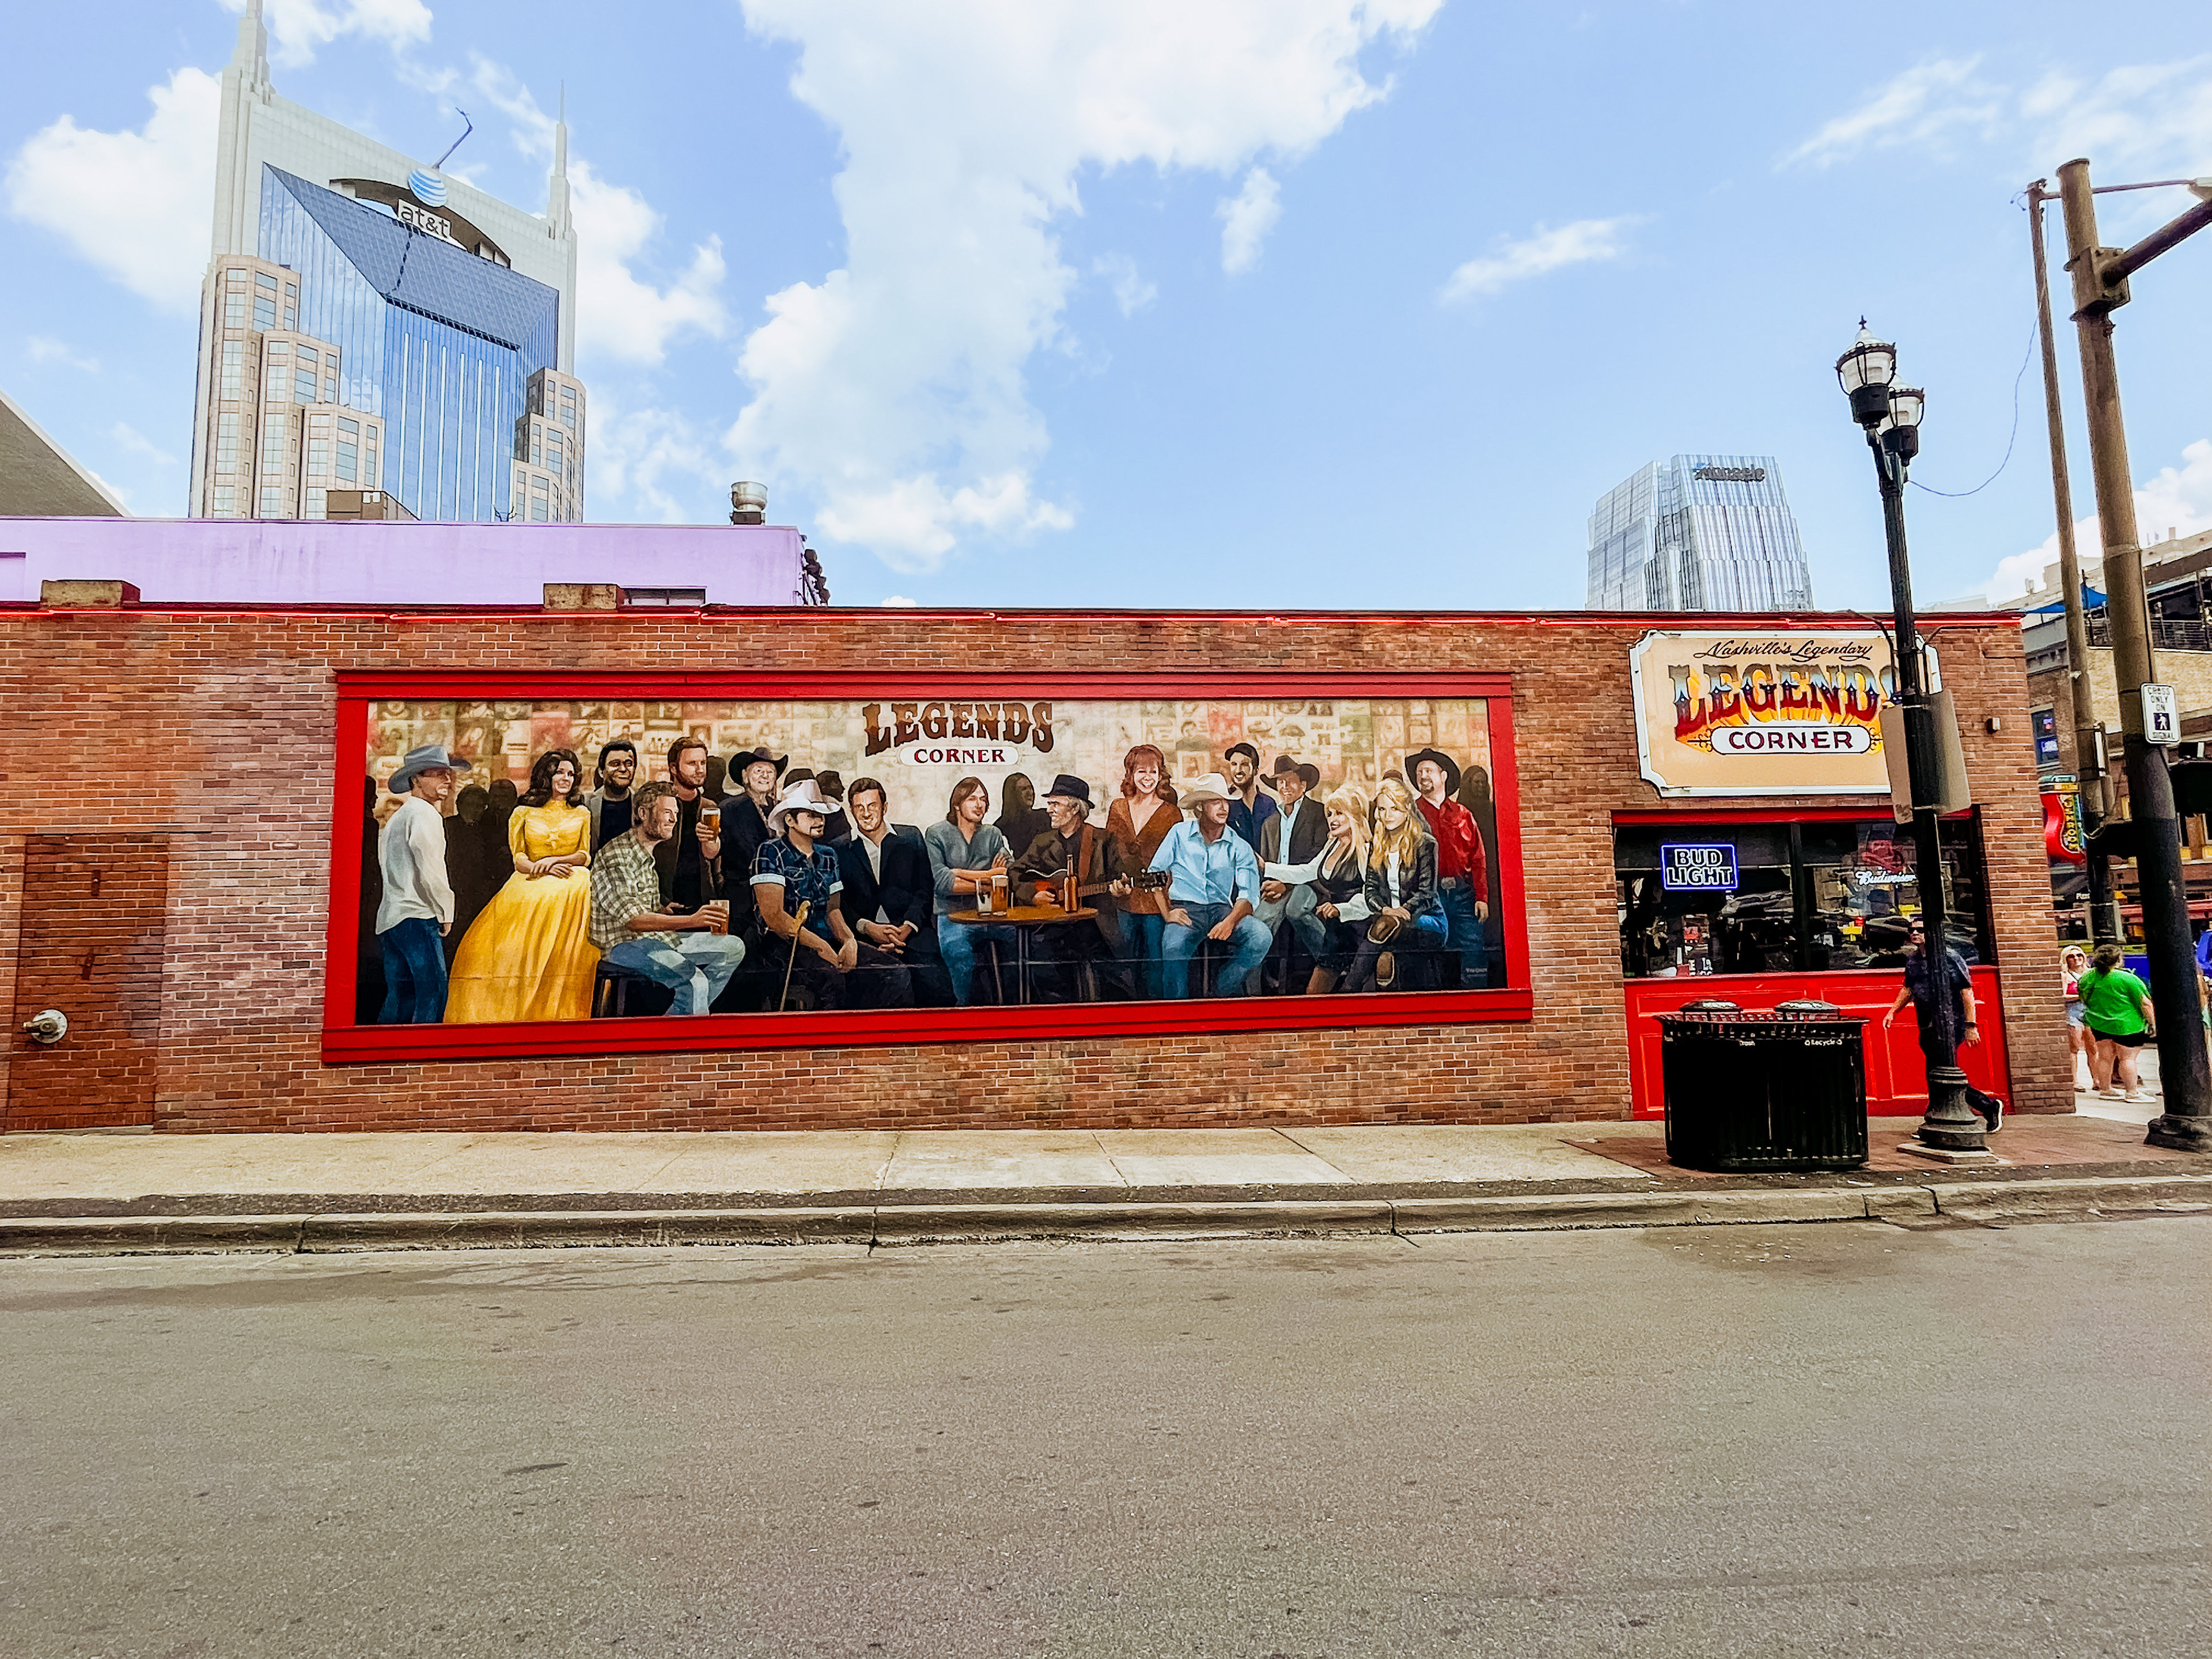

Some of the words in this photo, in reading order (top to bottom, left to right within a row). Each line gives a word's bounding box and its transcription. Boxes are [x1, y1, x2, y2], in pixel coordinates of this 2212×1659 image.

[401, 206, 449, 238] at&t
[1693, 639, 1791, 658] Nashville's
[1790, 639, 1873, 662] Legendary
[862, 702, 1054, 757] LEGENDS
[1729, 730, 1853, 750] CORNER
[914, 748, 1006, 764] CORNER
[1674, 849, 1723, 867] BUD
[1666, 866, 1733, 885] LIGHT
